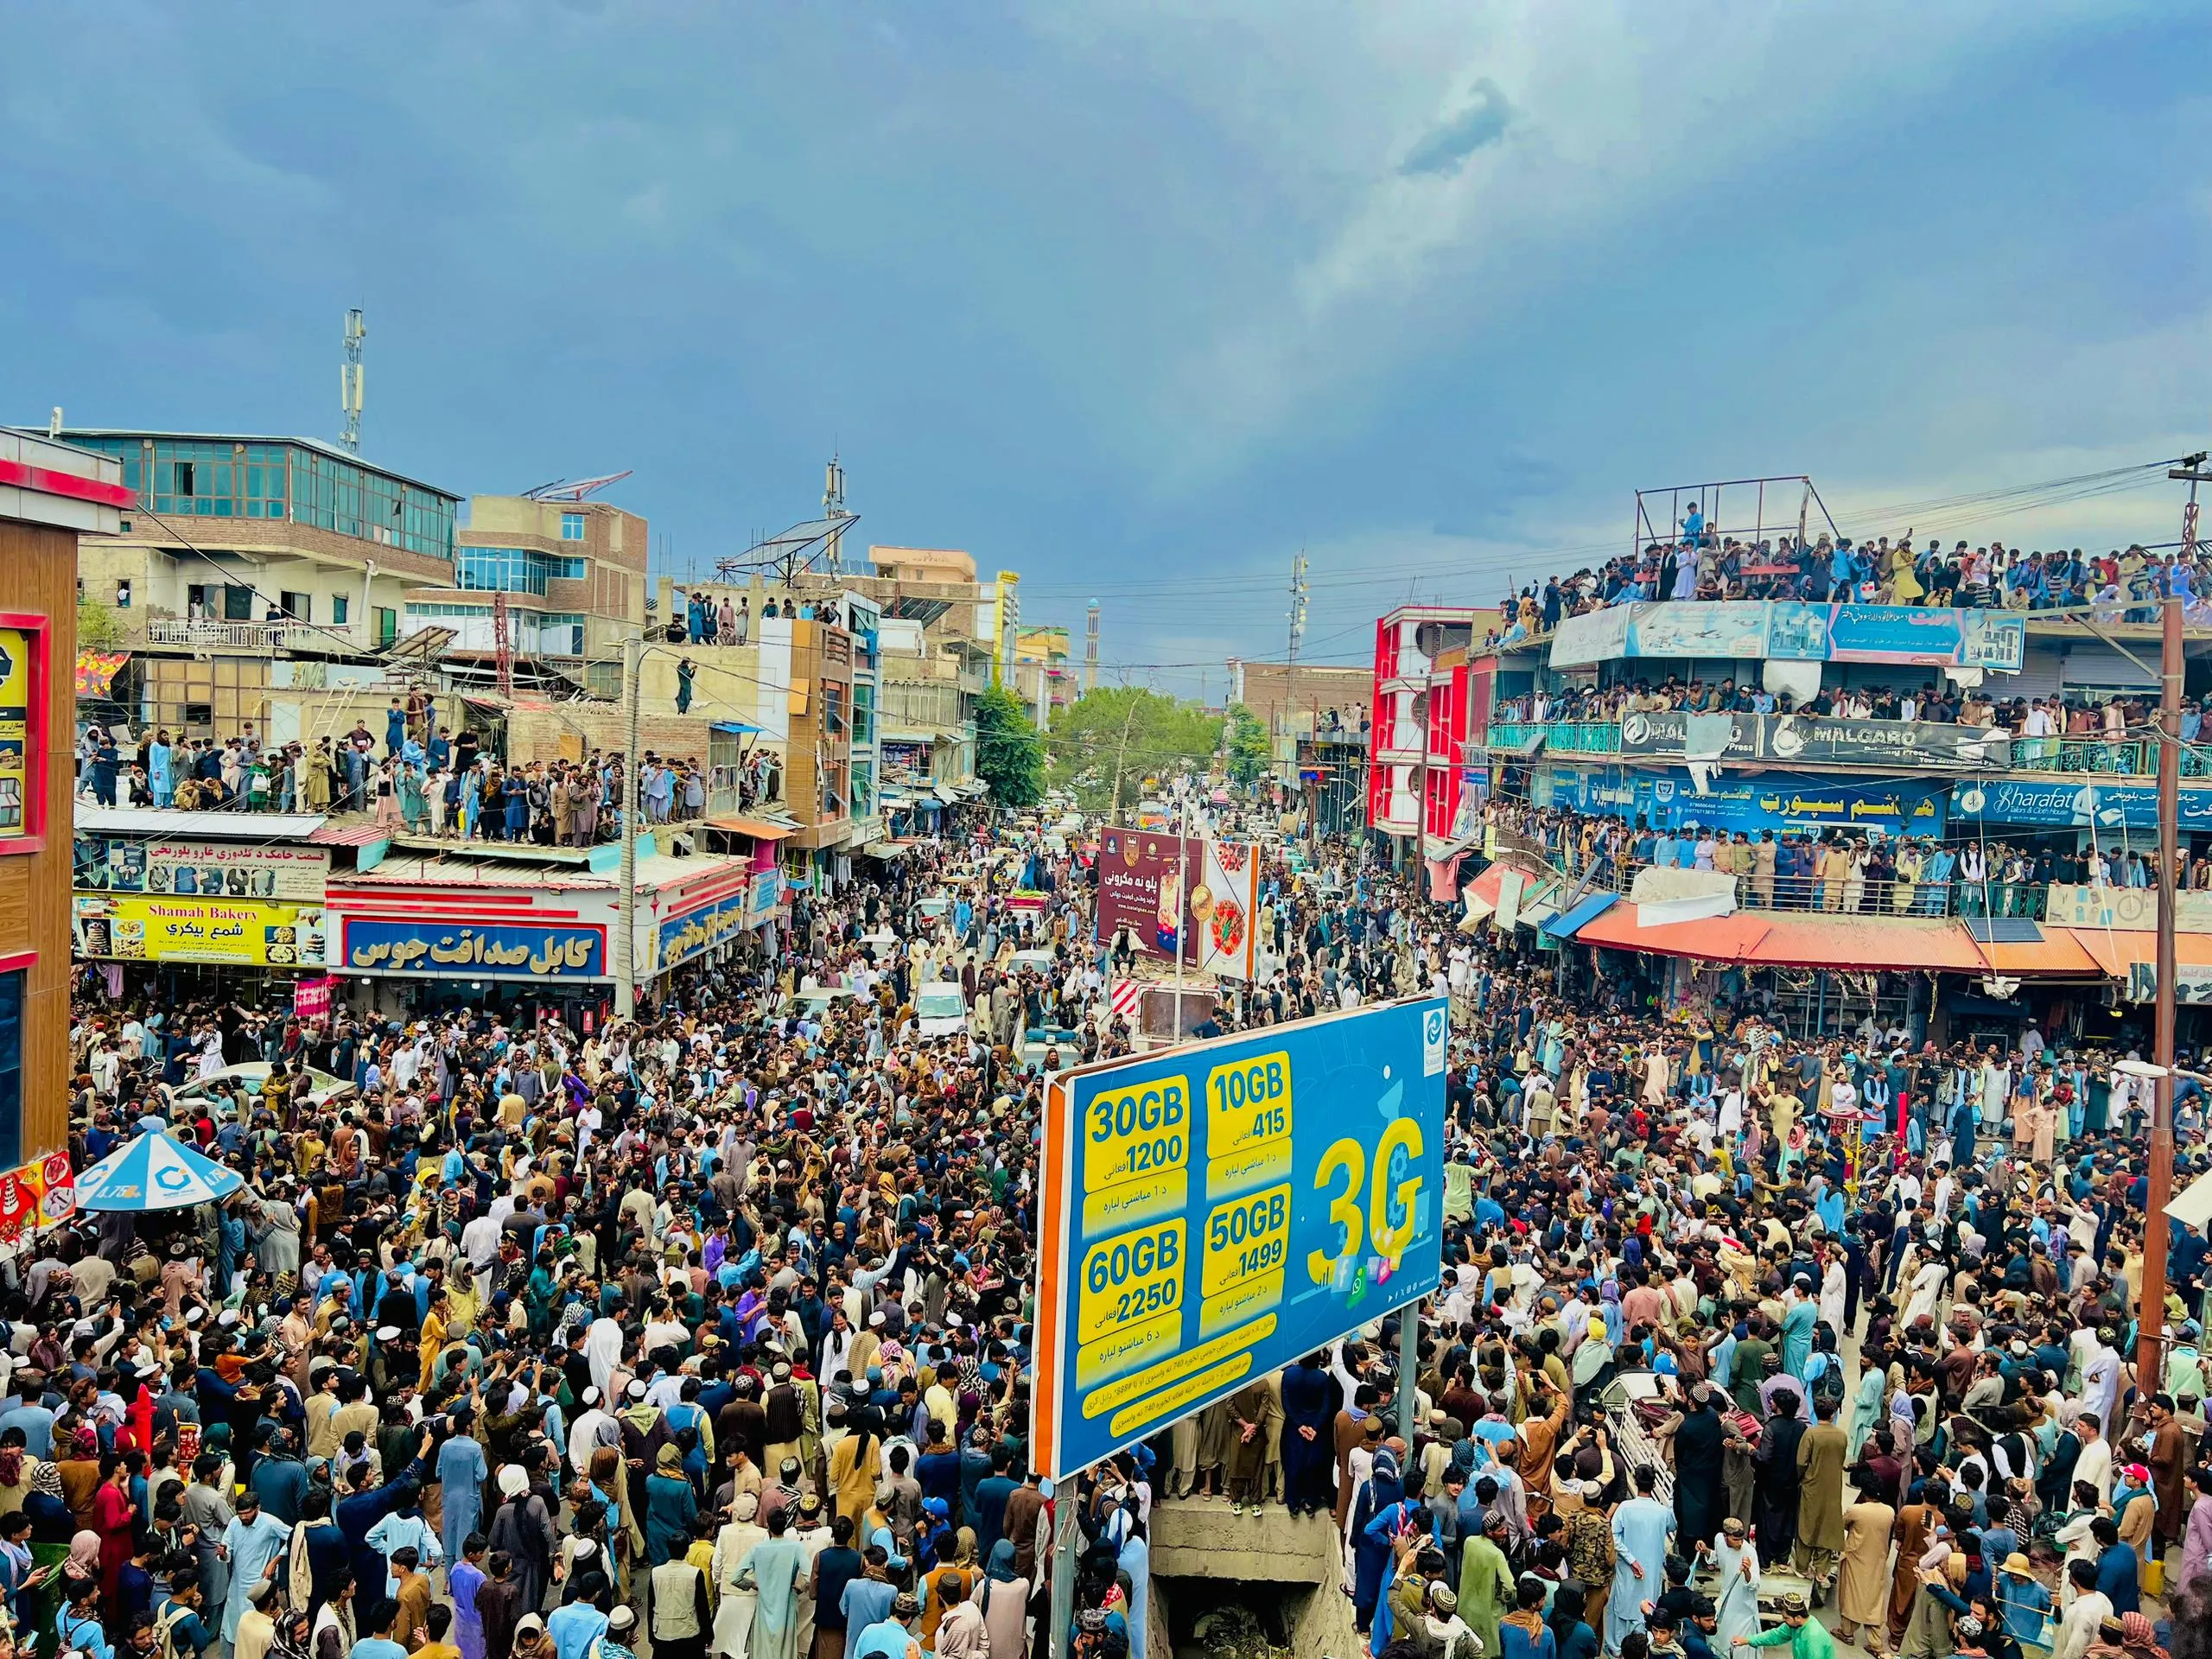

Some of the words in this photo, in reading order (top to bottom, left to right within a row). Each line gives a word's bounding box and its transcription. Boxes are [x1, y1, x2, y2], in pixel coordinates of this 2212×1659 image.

[1814, 726, 1916, 747] MALGARO
[1993, 784, 2074, 813] Sharafat
[257, 849, 263, 858] د
[296, 850, 325, 861] قسمت
[1135, 875, 1143, 887] نه
[1145, 875, 1158, 895] پلو
[149, 904, 204, 918] Shamah
[210, 906, 258, 923] Bakery
[210, 922, 244, 939] شمع
[353, 938, 429, 969] جوس
[430, 929, 530, 965] صداقت
[530, 935, 594, 975] کابل
[1215, 1062, 1284, 1112] 10GB
[1091, 1086, 1184, 1143] 30GB
[1253, 1107, 1285, 1138] 415
[1126, 1135, 1183, 1173] 1200
[1103, 1160, 1128, 1180] افغانی
[1154, 1185, 1159, 1196] 1
[1307, 1117, 1424, 1286] 3G
[1211, 1193, 1285, 1252] 50GB
[1088, 1230, 1179, 1294] 60GB
[1239, 1238, 1282, 1277] 1499
[1117, 1278, 1177, 1324] 2250
[1257, 1286, 1262, 1297] 2
[1095, 1306, 1120, 1329] افغانی
[1147, 1331, 1153, 1341] 6
